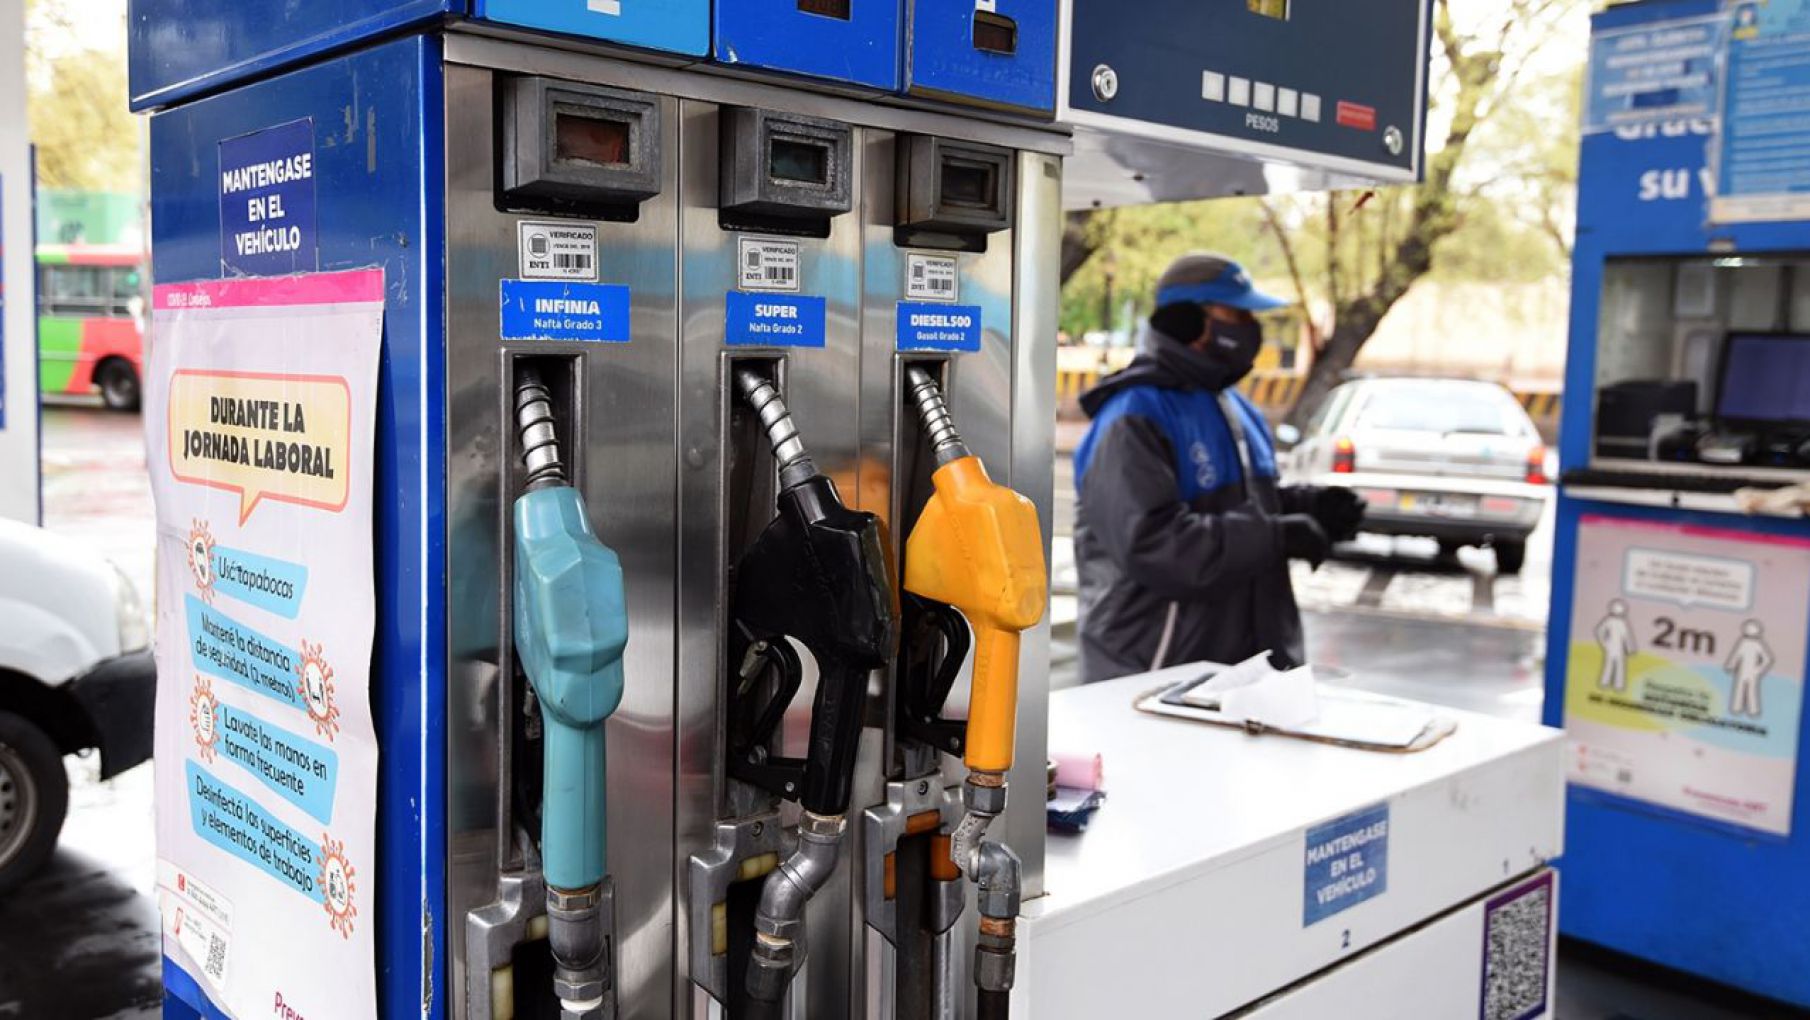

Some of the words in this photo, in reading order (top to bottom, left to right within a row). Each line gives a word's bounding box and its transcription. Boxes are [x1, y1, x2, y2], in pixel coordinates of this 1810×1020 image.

[1246, 113, 1278, 133] PESOS
[224, 153, 311, 194] MANTENGASE
[1638, 167, 1689, 201] su
[248, 197, 265, 222] EN
[268, 194, 285, 218] EL
[235, 225, 300, 256] VEHÍCULO
[550, 231, 592, 240] VERIFICADO
[762, 246, 796, 255] VERIFICADO
[530, 261, 550, 270] INTI
[536, 299, 600, 314] INFINIA
[755, 304, 798, 318] SUPER
[534, 318, 562, 329] Nafta
[564, 319, 594, 330] Grado
[596, 320, 602, 330] 3
[750, 322, 772, 332] Nafta
[772, 323, 796, 334] Grado
[798, 324, 803, 334] 2
[916, 331, 938, 340] Gasoil
[940, 332, 960, 341] Grado
[210, 396, 278, 430] DURANTE
[283, 402, 305, 432] LA
[184, 429, 250, 466] JORNADA
[254, 438, 334, 479] LABORAL
[238, 566, 292, 599] tapabocas
[196, 635, 208, 656] de
[202, 612, 235, 647] Mantené
[235, 628, 245, 652] la
[248, 635, 290, 672] distancia
[1652, 616, 1716, 654] 2m
[224, 707, 258, 744] Lavate
[258, 726, 272, 752] las
[275, 741, 310, 772] manos
[313, 759, 327, 780] en
[225, 734, 256, 768] forma
[256, 750, 304, 796] frecuente
[196, 775, 242, 820] Desinfectá
[245, 803, 258, 830] las
[261, 819, 312, 864] superficies
[202, 808, 208, 826] y
[208, 811, 257, 854] elementos
[259, 841, 272, 864] de
[274, 850, 313, 892] trabajo
[1308, 820, 1387, 866] MANTENGASE
[1330, 858, 1346, 878] EN
[1349, 852, 1364, 870] EL
[1317, 867, 1376, 904] VEHÍCULO
[1342, 928, 1350, 948] 2
